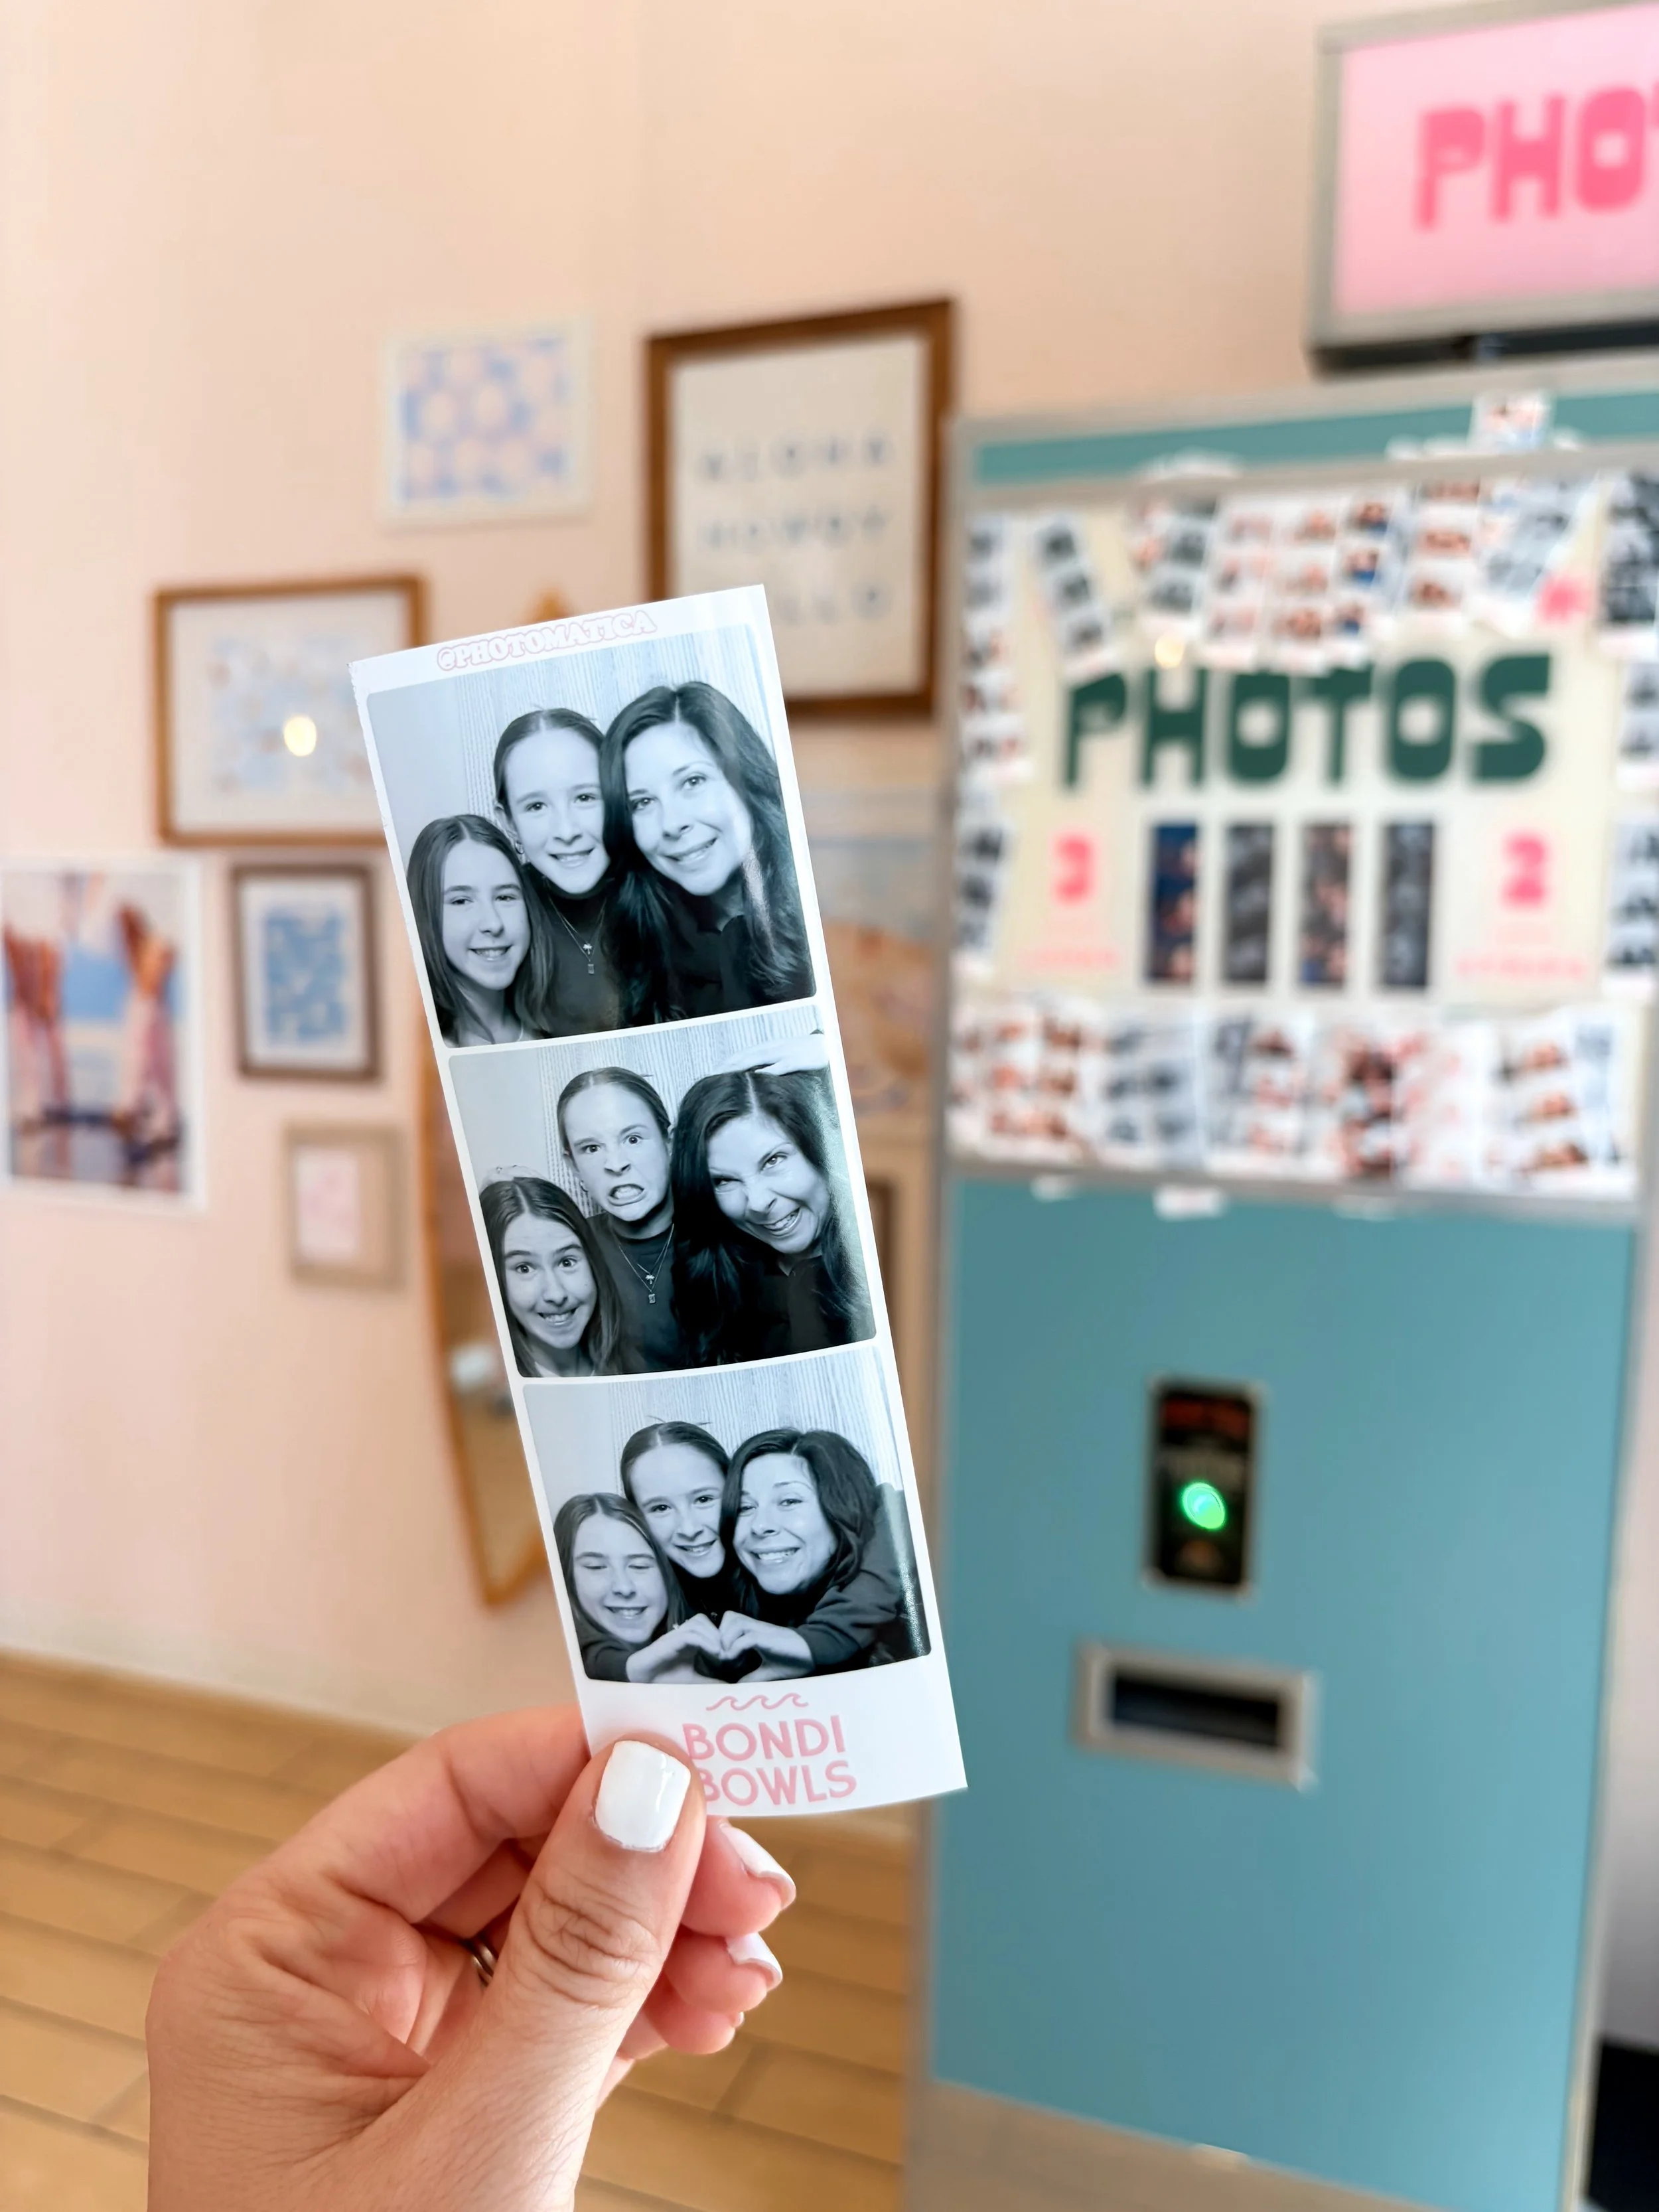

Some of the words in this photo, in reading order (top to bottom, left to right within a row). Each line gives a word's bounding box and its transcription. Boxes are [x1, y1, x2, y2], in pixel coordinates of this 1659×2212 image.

[1415, 81, 1659, 232] PHO
[1063, 653, 1553, 788] PHOTOS
[682, 1715, 847, 1761] BONDI
[698, 1760, 857, 1806] BOWLS
